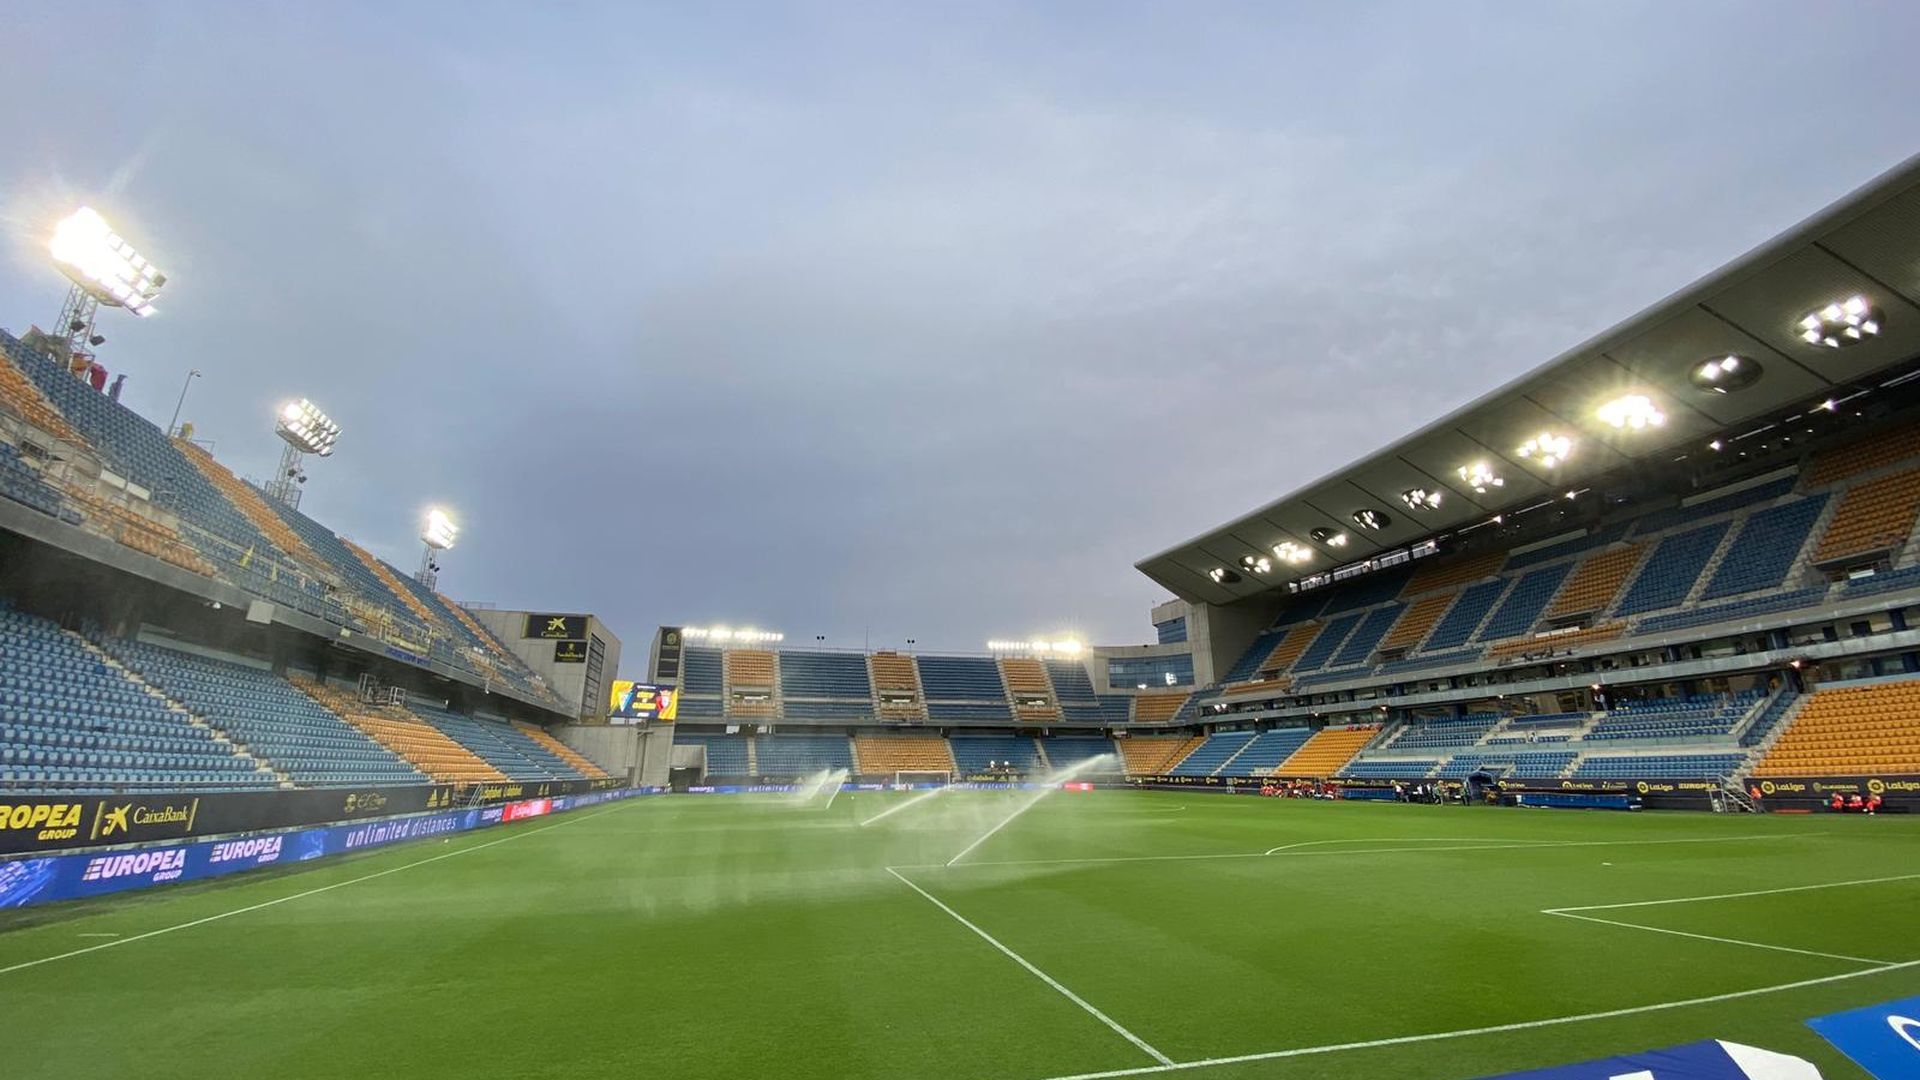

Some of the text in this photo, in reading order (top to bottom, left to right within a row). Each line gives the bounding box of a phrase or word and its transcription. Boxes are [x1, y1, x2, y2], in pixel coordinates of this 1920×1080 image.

[1649, 784, 1674, 792] LaLiga
[1775, 782, 1806, 792] LaLiga
[1885, 781, 1920, 791] LaLiga
[133, 805, 188, 824] CaixaBank
[38, 829, 77, 840] GROUP
[346, 817, 457, 848] unlimited distances
[209, 836, 283, 863] EUROPEA
[82, 849, 186, 881] EUROPEA
[153, 869, 182, 882] GROUP
